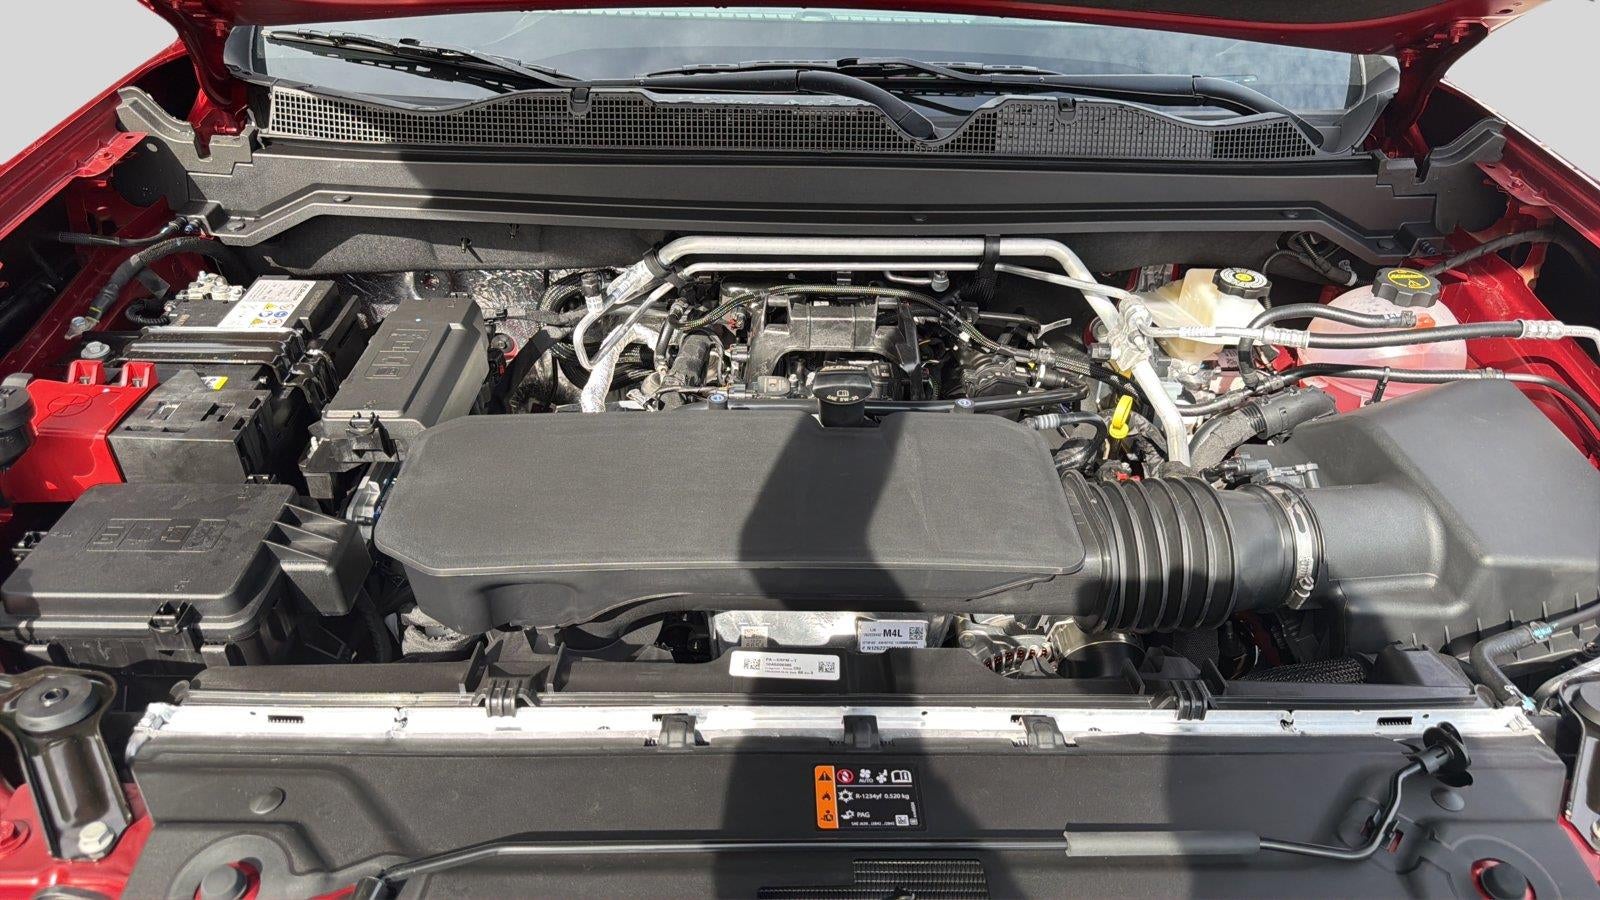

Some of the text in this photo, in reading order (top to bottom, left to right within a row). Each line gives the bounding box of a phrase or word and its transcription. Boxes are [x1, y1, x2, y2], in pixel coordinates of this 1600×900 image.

[883, 629, 903, 638] M4L
[901, 793, 910, 801] kg
[856, 811, 871, 819] PAG
